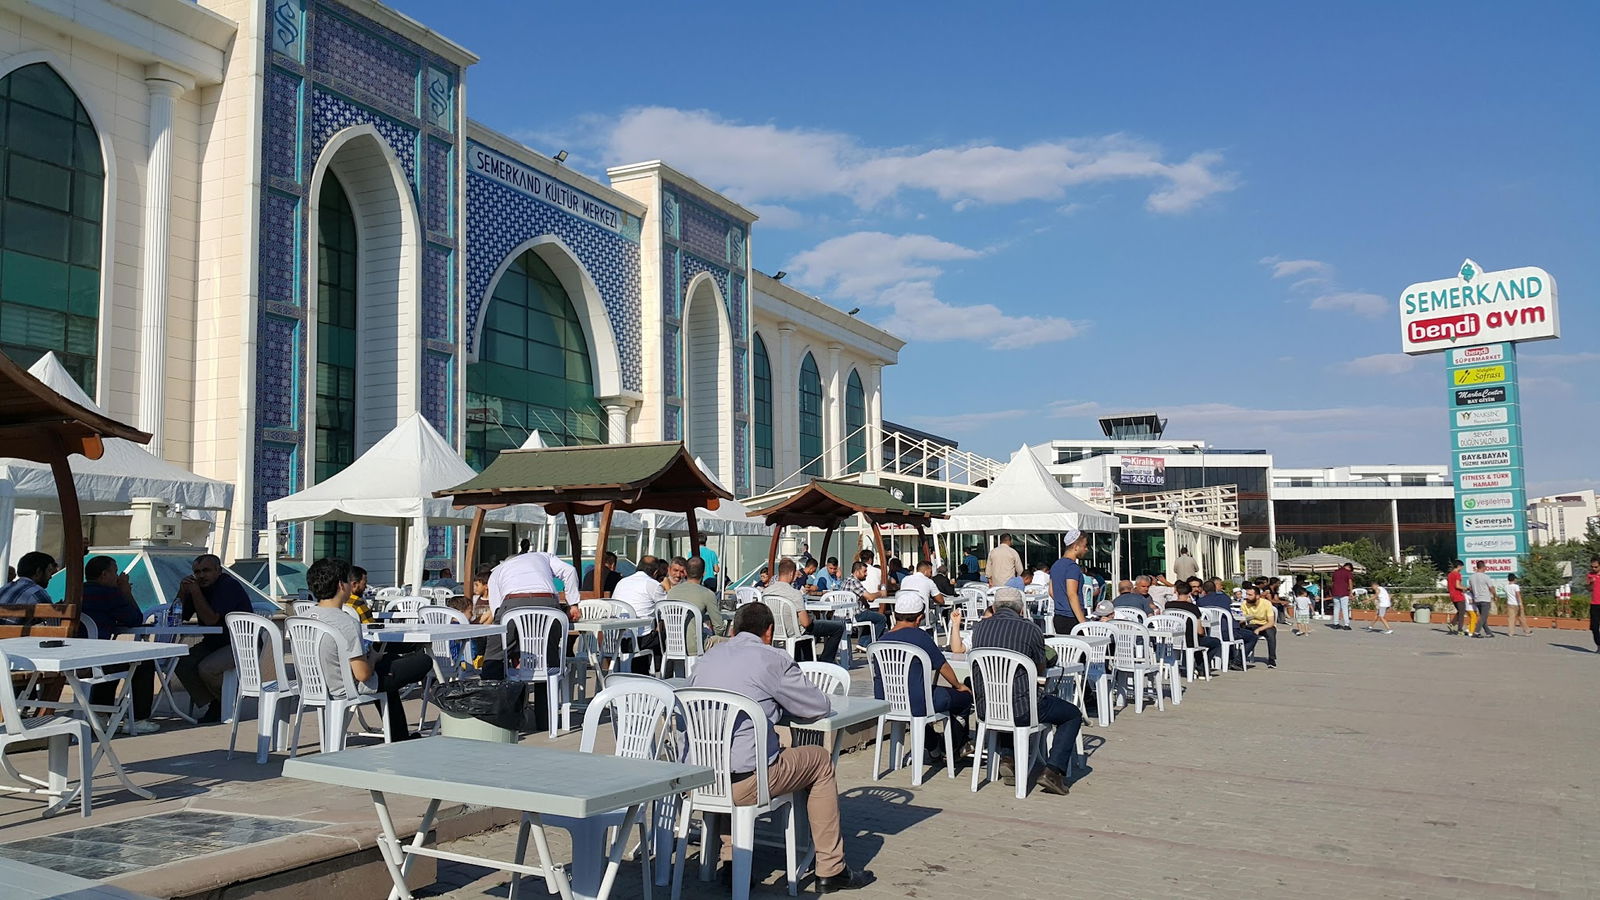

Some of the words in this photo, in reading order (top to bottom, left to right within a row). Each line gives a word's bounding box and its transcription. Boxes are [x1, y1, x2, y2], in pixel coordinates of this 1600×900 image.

[476, 151, 541, 195] SEMERKAND
[545, 182, 578, 213] KÜLTÜR
[582, 203, 617, 230] MERKEZİ
[1405, 276, 1543, 315] SEMERKAND
[1410, 315, 1476, 340] bendi
[1486, 306, 1546, 329] avm
[1455, 354, 1501, 364] SÜPERMARKET
[1473, 372, 1501, 382] Sofrası
[1461, 452, 1508, 461] BAY&BAYAN
[1131, 457, 1155, 466] Kiralık
[1132, 475, 1146, 483] 242
[1476, 498, 1511, 507] yeşilelma
[1474, 517, 1512, 525] Semerşah
